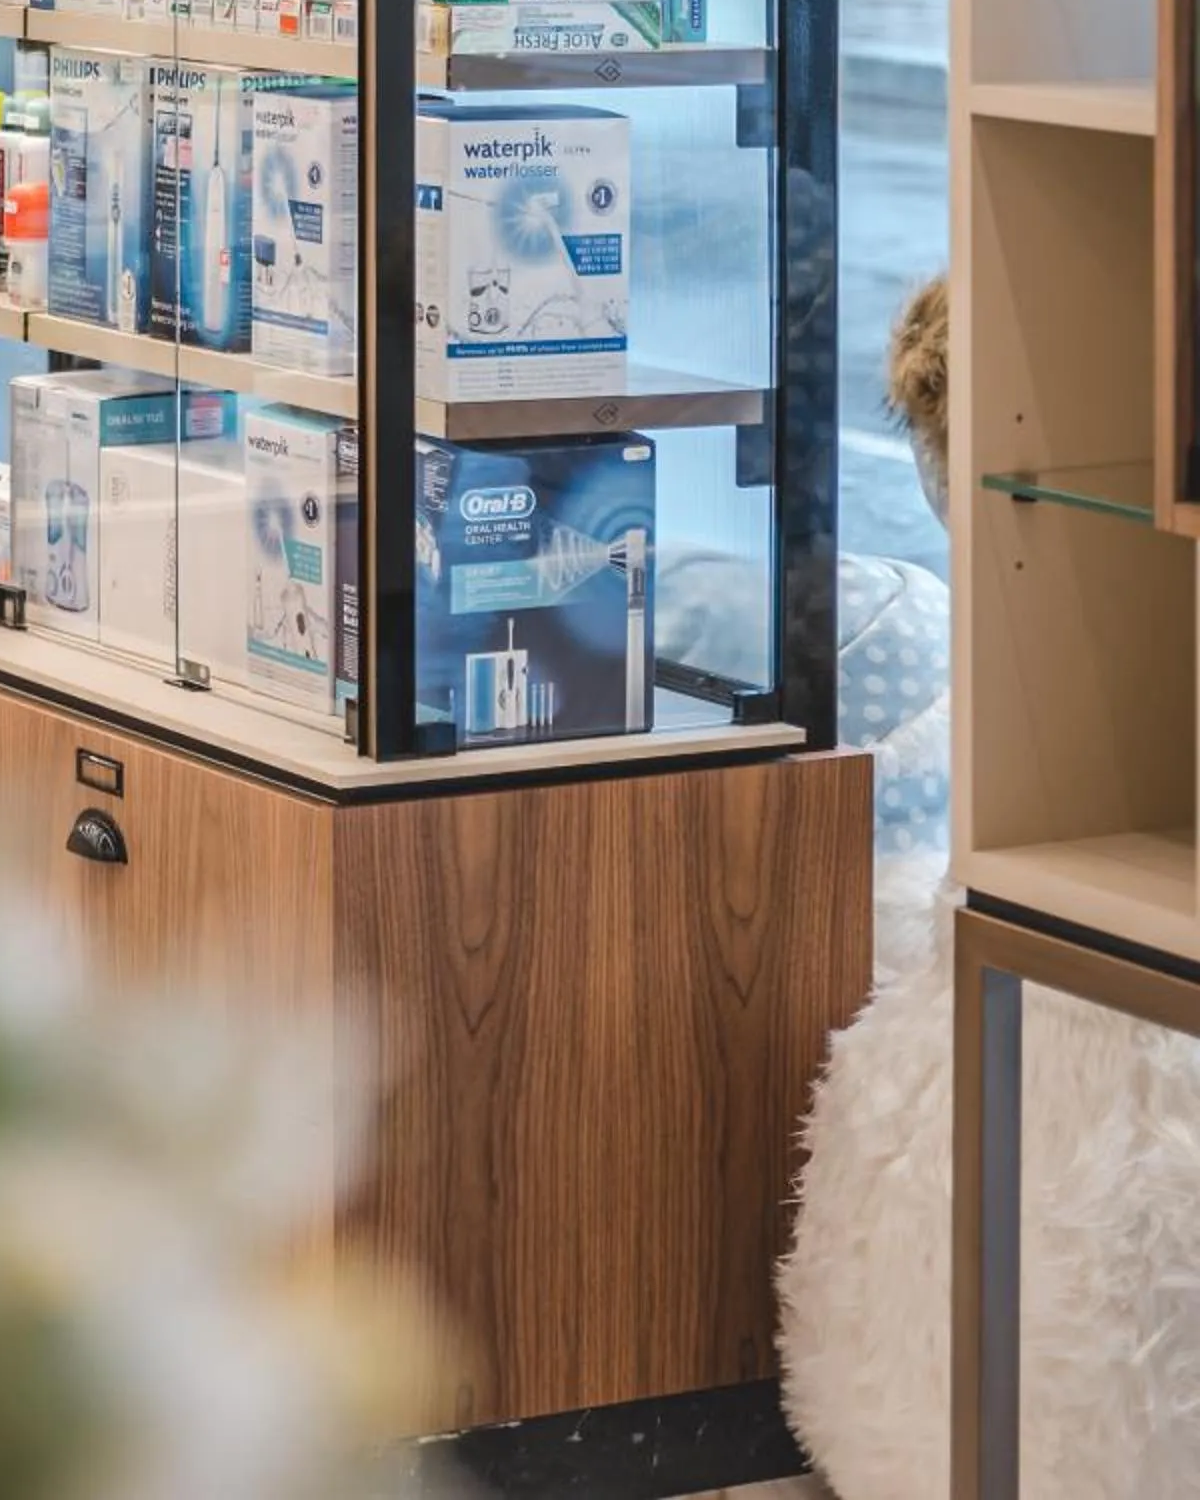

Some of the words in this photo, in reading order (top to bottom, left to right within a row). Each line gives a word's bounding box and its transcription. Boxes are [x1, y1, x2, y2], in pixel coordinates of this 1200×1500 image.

[513, 33, 560, 49] FRESH
[563, 32, 604, 48] ALOE
[53, 57, 100, 80] PHILIPS
[463, 131, 554, 161] waterpik
[463, 163, 559, 179] waterflosser
[247, 434, 289, 457] waterpik
[467, 492, 527, 515] Oral-B
[465, 524, 492, 535] ORAL
[492, 521, 531, 534] HEALTH
